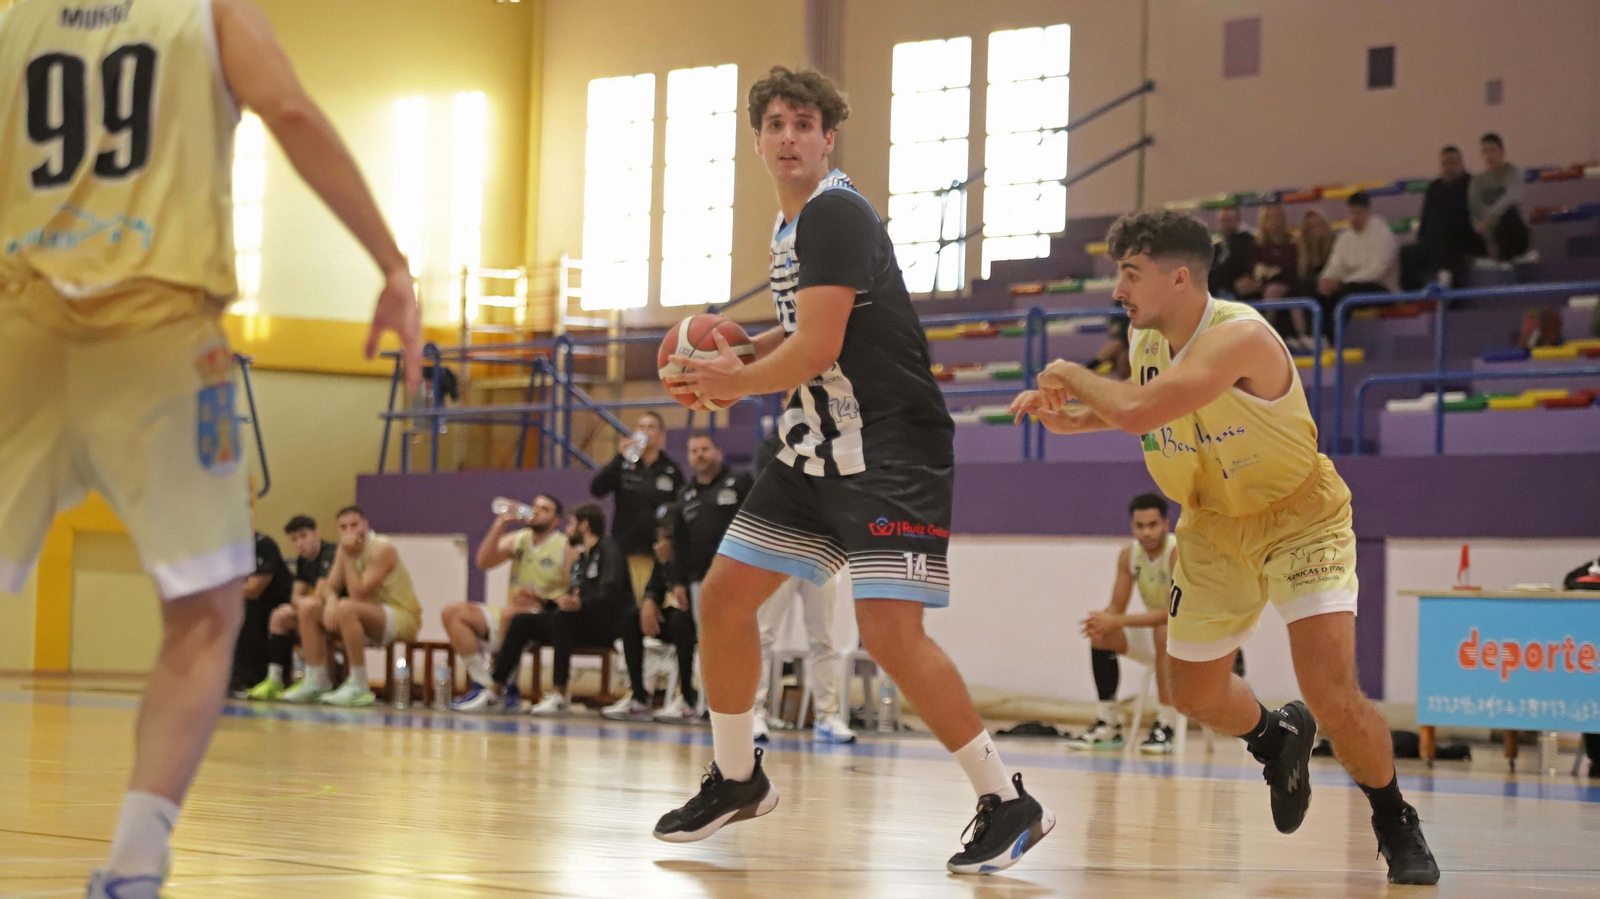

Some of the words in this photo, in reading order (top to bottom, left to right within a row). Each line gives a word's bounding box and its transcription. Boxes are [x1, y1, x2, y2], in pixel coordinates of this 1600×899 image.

[26, 42, 157, 189] 99
[828, 396, 859, 423] 14
[902, 521, 926, 535] Ruiz
[903, 551, 928, 581] 14
[1284, 567, 1319, 581] ARNICAS
[1457, 627, 1600, 683] deporte
